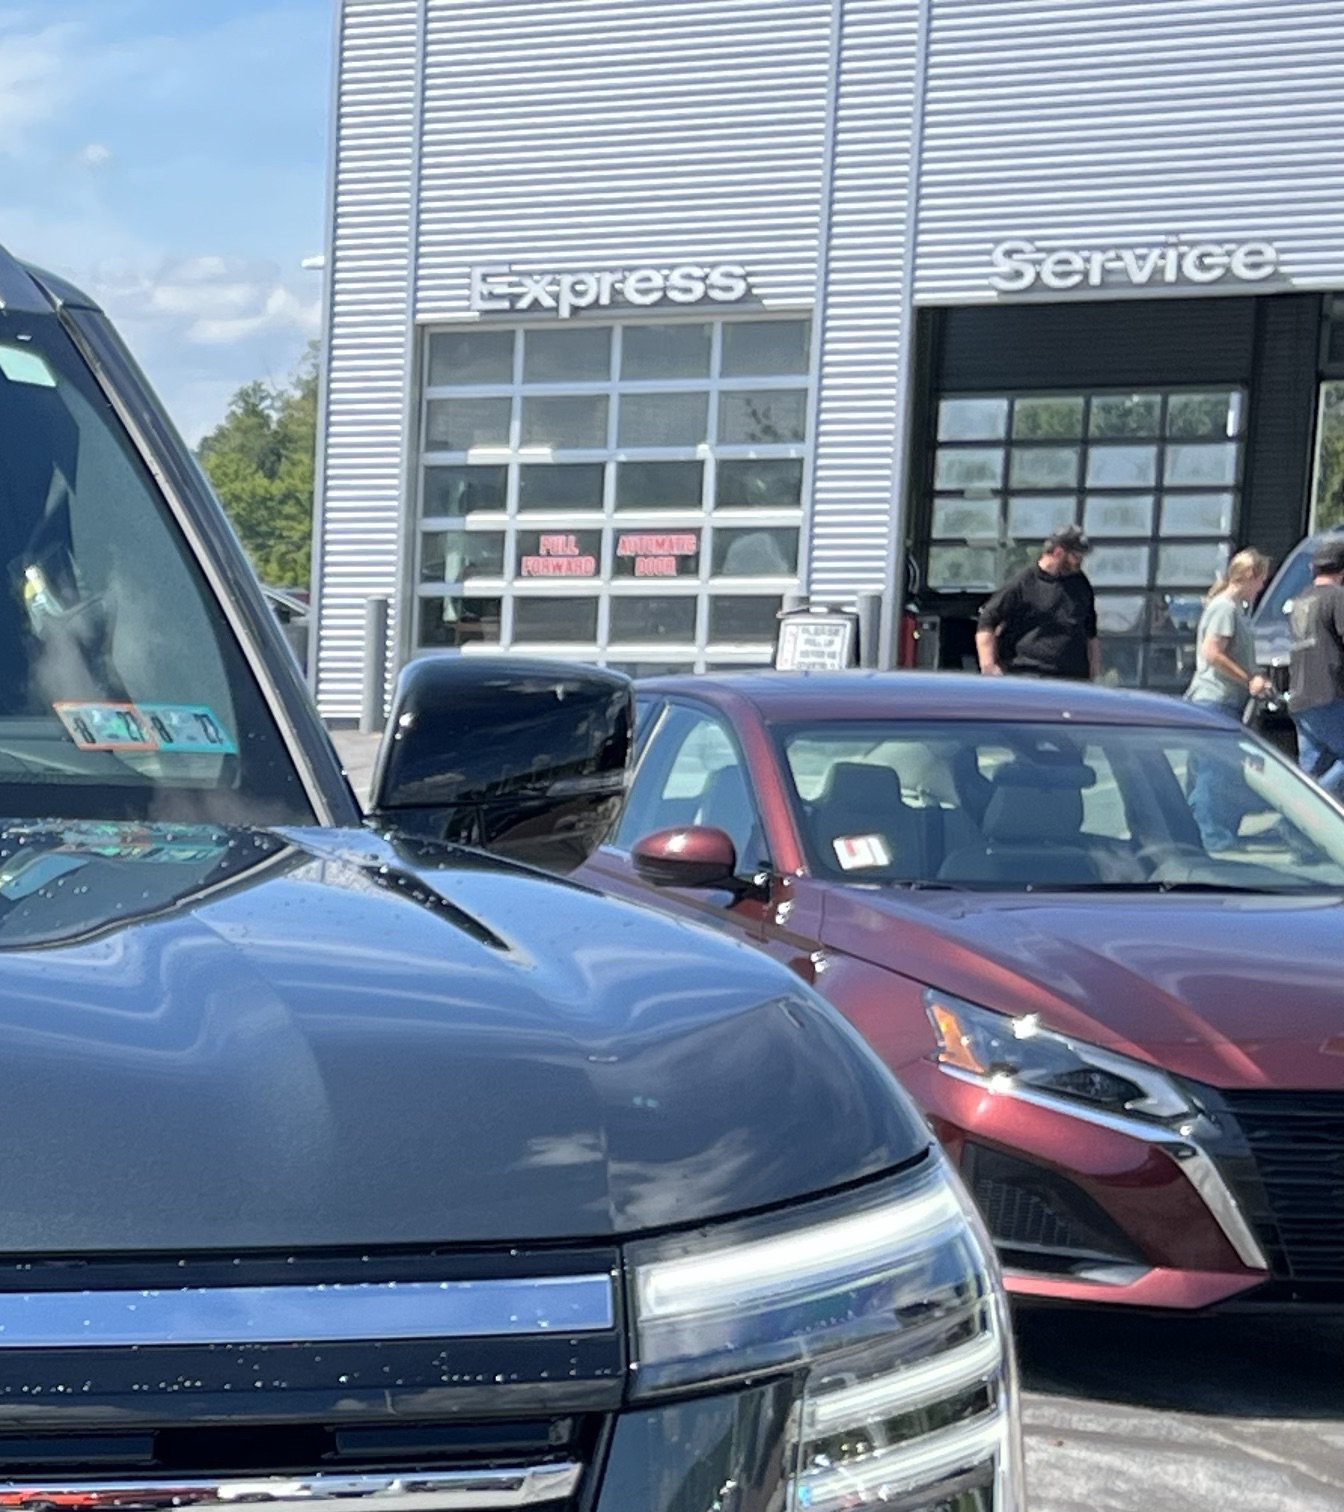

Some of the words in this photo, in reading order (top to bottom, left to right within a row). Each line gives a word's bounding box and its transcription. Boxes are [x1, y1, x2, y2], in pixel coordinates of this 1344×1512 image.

[988, 234, 1277, 291] Service
[470, 264, 746, 319] Express
[540, 535, 579, 556] PULL
[521, 556, 596, 577] FORWARD
[634, 556, 677, 577] DOOR
